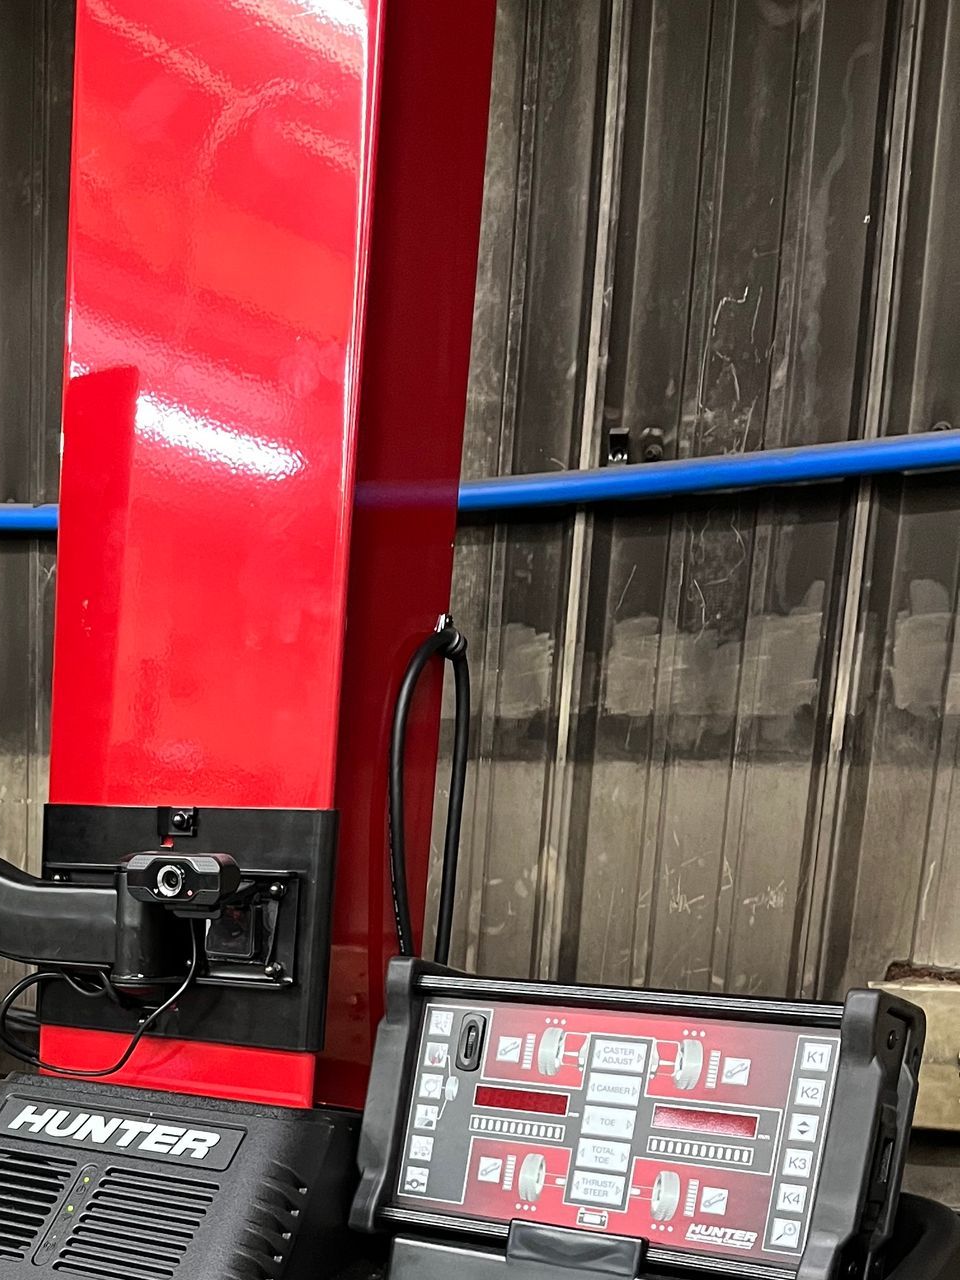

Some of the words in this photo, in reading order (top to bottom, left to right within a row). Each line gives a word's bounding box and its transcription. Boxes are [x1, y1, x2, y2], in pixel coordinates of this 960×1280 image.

[603, 1046, 635, 1056] CASTER
[602, 1056, 633, 1066] ADJUST
[806, 1051, 825, 1064] K1
[596, 1084, 630, 1095] CAMBER
[800, 1087, 819, 1100] K2
[600, 1117, 616, 1127] TOE
[8, 1104, 221, 1160] HUNTER
[592, 1145, 615, 1156] TOTAL
[594, 1156, 610, 1165] TOE
[788, 1156, 807, 1170] K3
[581, 1177, 616, 1188] THRUST/
[583, 1187, 609, 1198] STEER
[782, 1191, 800, 1205] K4
[686, 1223, 758, 1242] HUNTER
